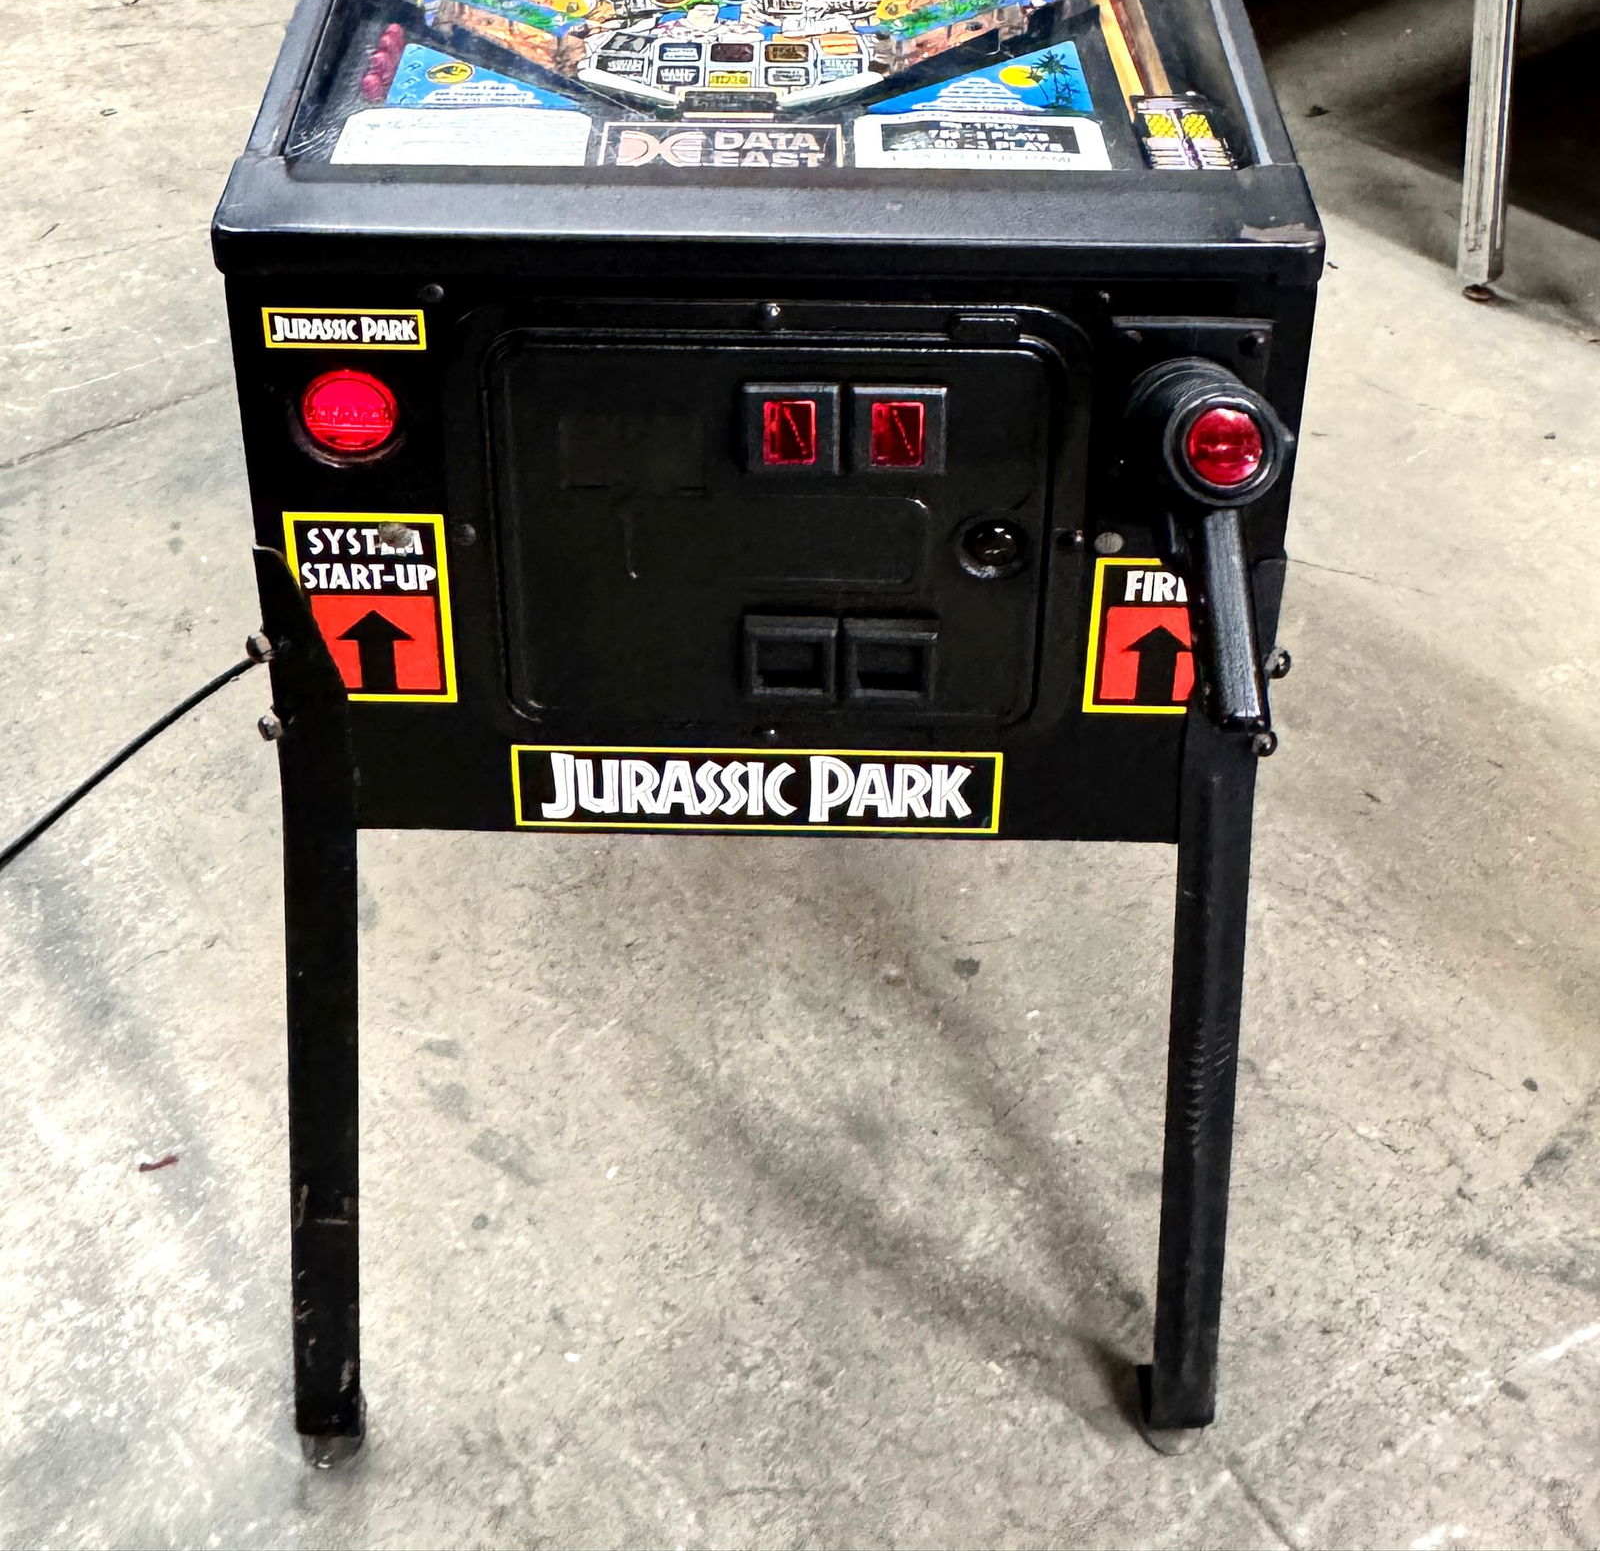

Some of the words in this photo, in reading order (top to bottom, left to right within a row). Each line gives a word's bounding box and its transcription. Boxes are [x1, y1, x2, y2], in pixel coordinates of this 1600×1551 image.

[714, 131, 820, 150] DATA
[706, 152, 826, 168] EAST
[272, 316, 358, 341] JURASSIC
[360, 317, 417, 342] PARK
[307, 528, 424, 556] SYST
[301, 562, 436, 591] START-UP
[542, 752, 797, 819] JURASSIC
[808, 756, 973, 823] PARK
